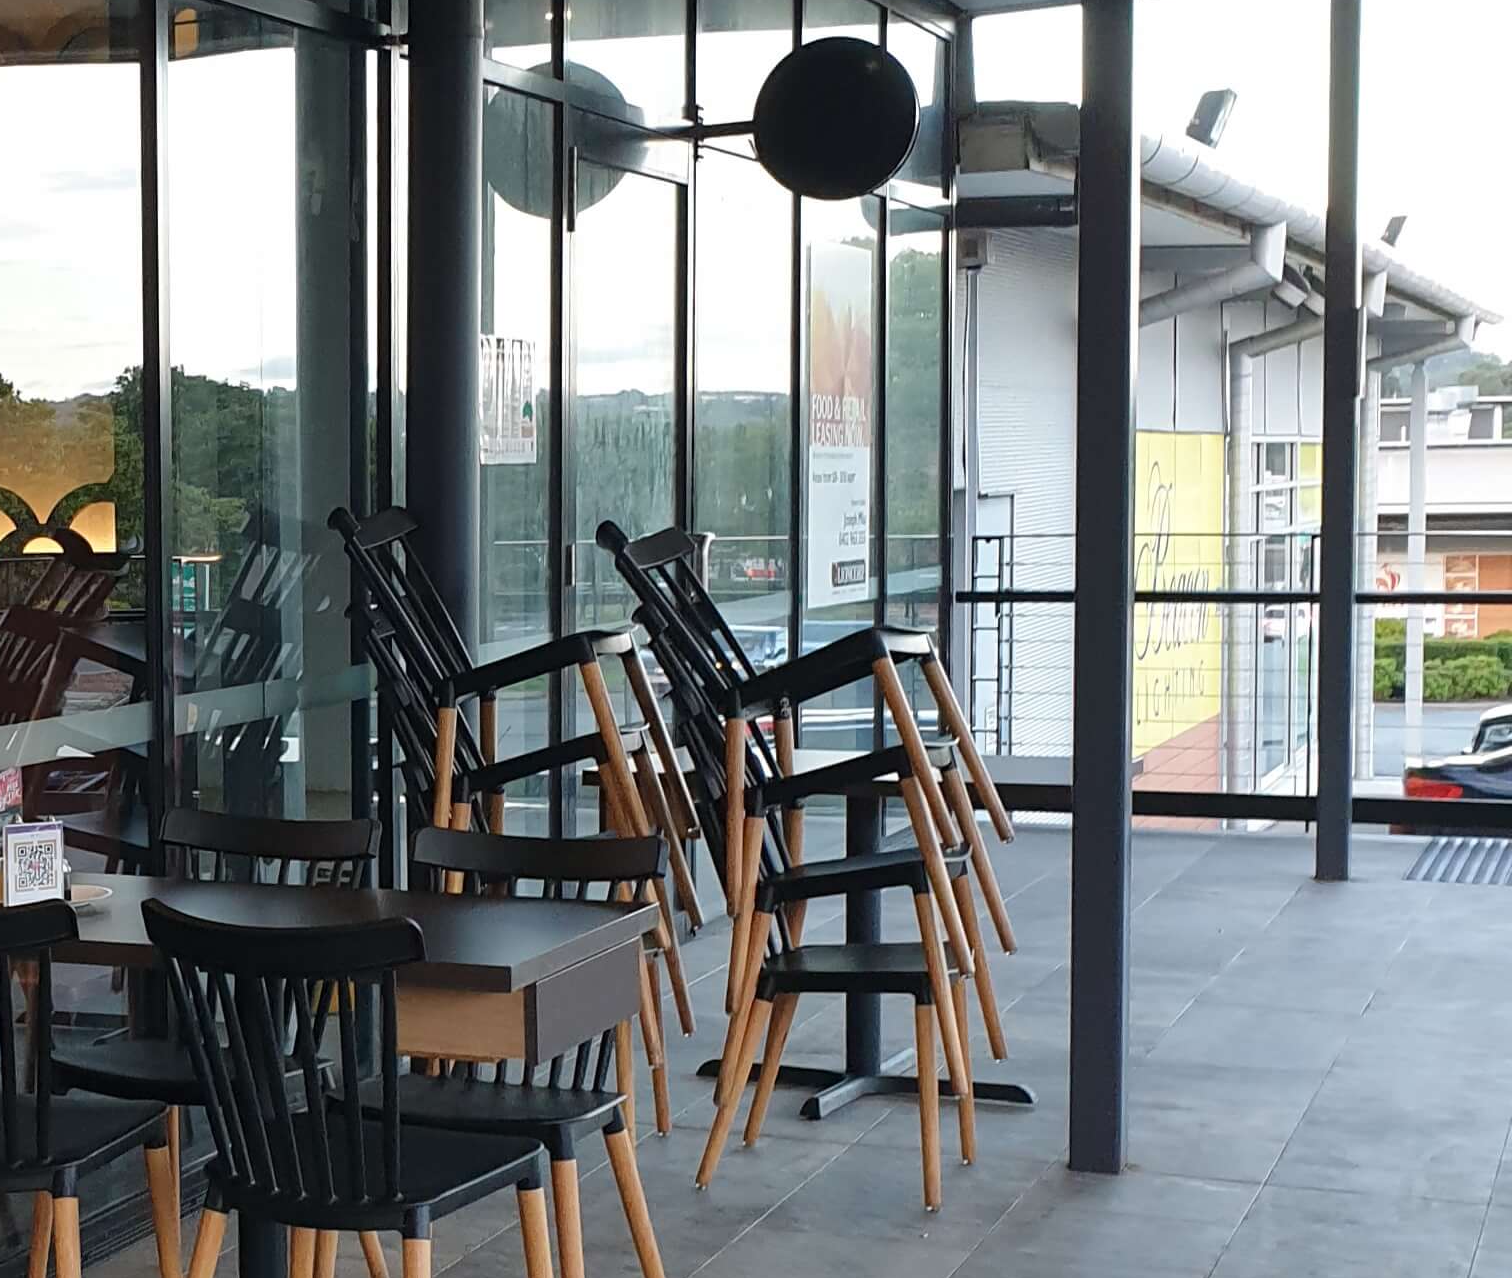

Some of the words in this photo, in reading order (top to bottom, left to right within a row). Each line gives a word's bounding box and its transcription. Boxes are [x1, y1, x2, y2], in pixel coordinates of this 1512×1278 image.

[812, 394, 833, 420] FOOD
[812, 421, 844, 447] LEASING
[1136, 659, 1206, 727] LIGHTING
